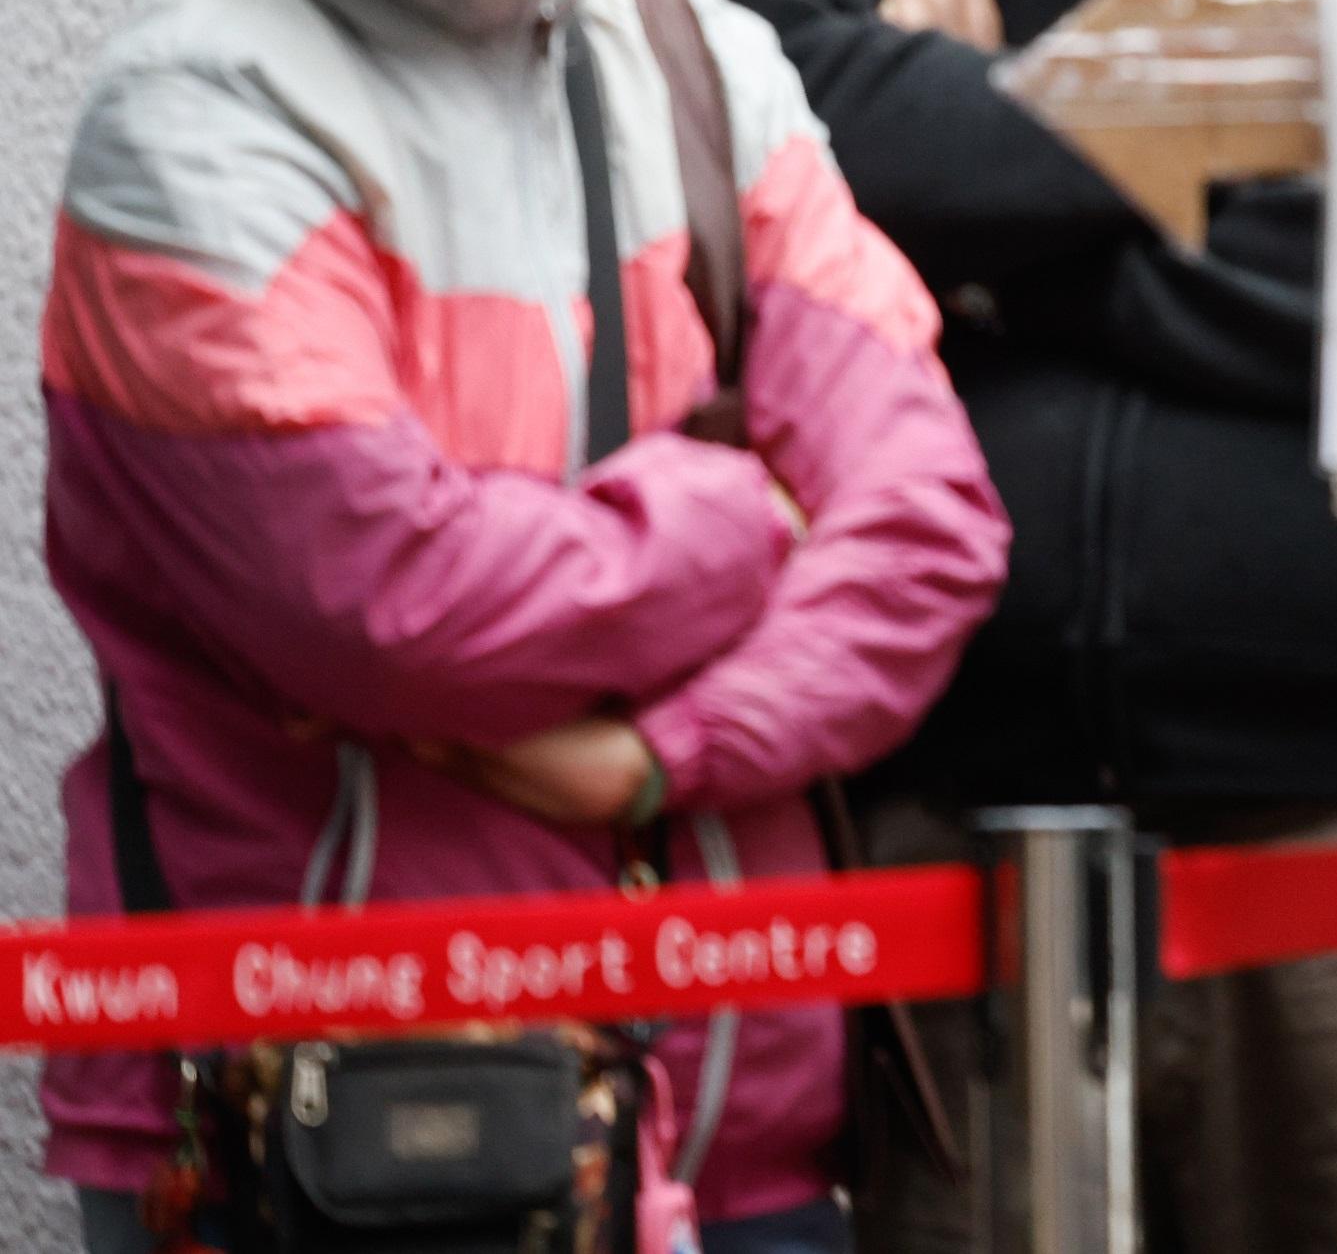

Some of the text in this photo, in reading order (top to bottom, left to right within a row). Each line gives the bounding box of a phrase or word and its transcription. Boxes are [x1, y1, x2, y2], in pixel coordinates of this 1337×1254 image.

[21, 914, 878, 1024] Kwun Chung Sport Centre
